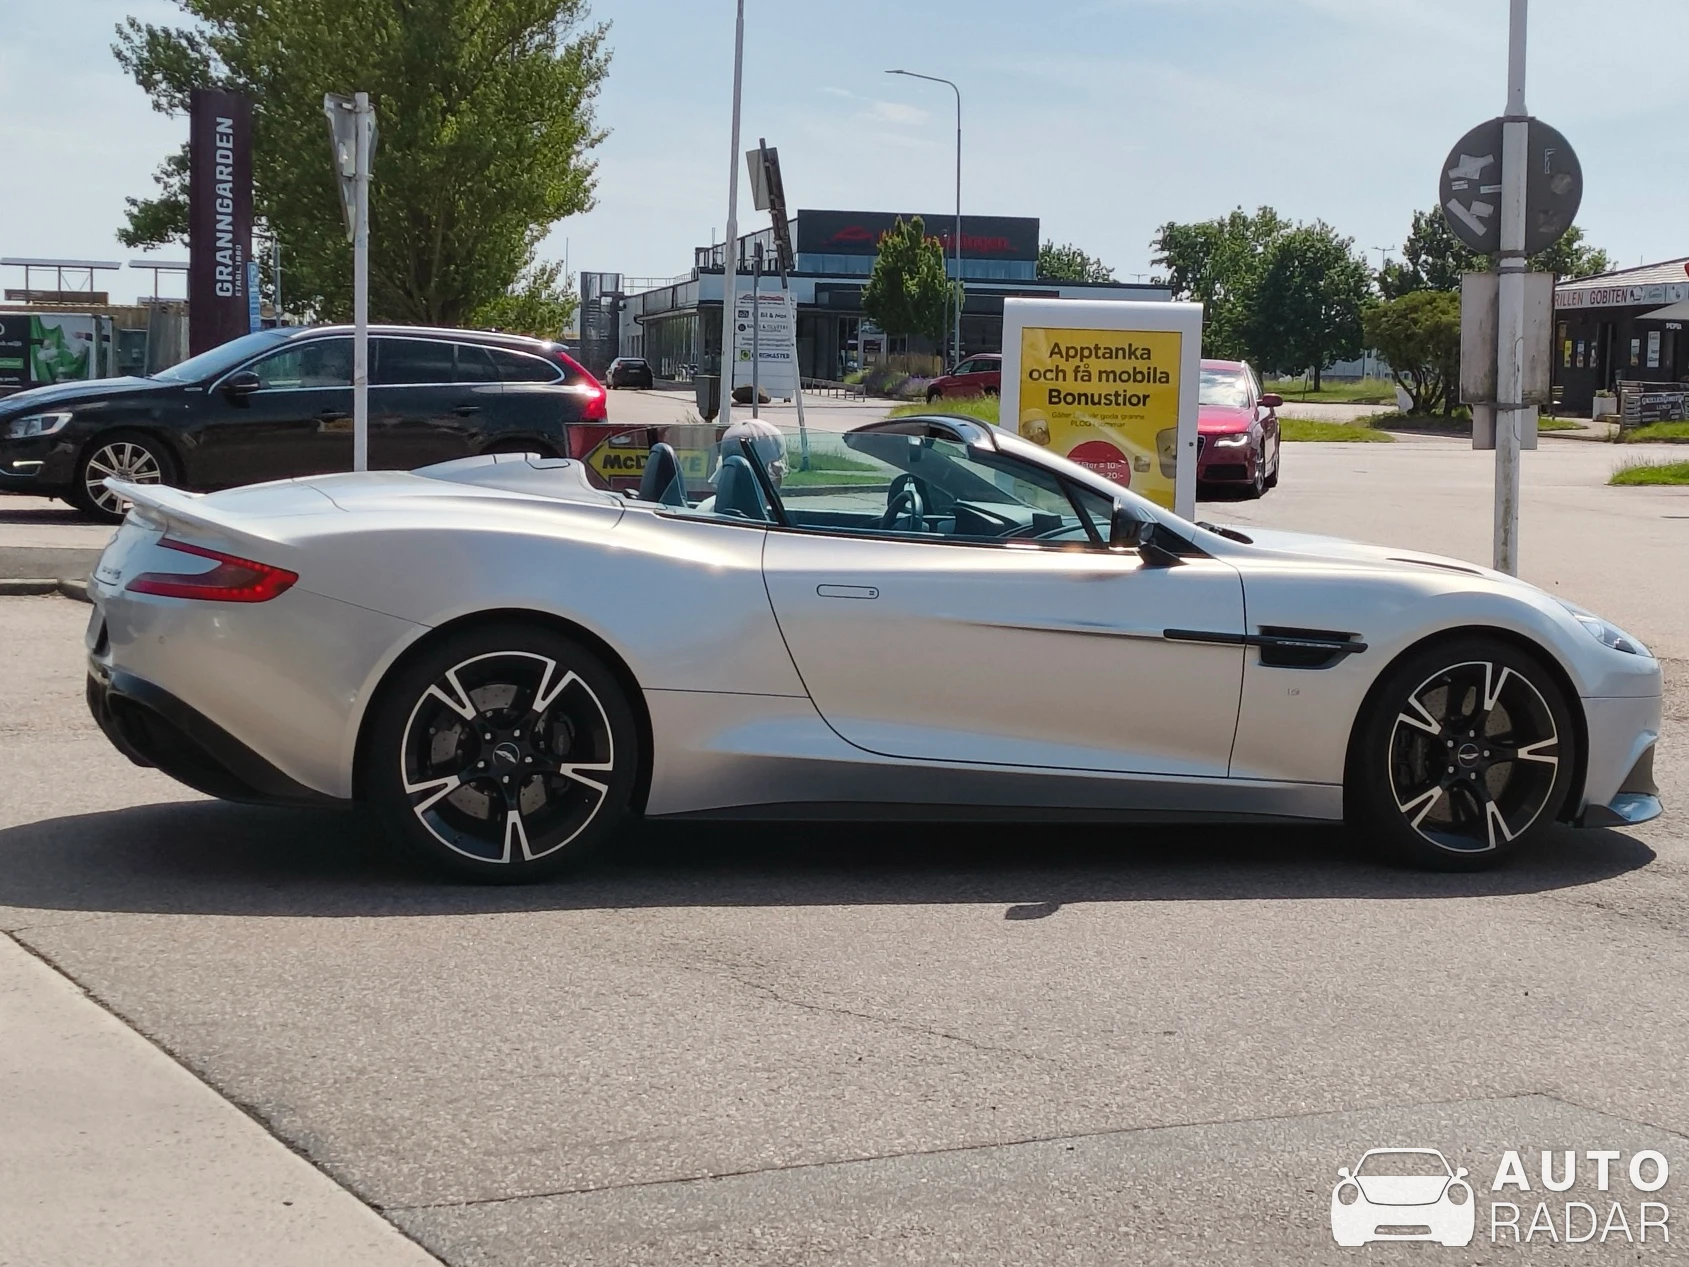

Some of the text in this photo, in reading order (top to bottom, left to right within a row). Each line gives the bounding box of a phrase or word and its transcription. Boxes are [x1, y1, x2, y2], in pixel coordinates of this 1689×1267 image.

[215, 116, 234, 297] GRANNGÅRDEN
[1555, 288, 1628, 306] RILLEN GOBITEN
[1048, 342, 1152, 362] Apptanka
[1028, 363, 1170, 384] och få mobila
[1048, 388, 1151, 407] Bonustior
[602, 454, 702, 473] McDVE
